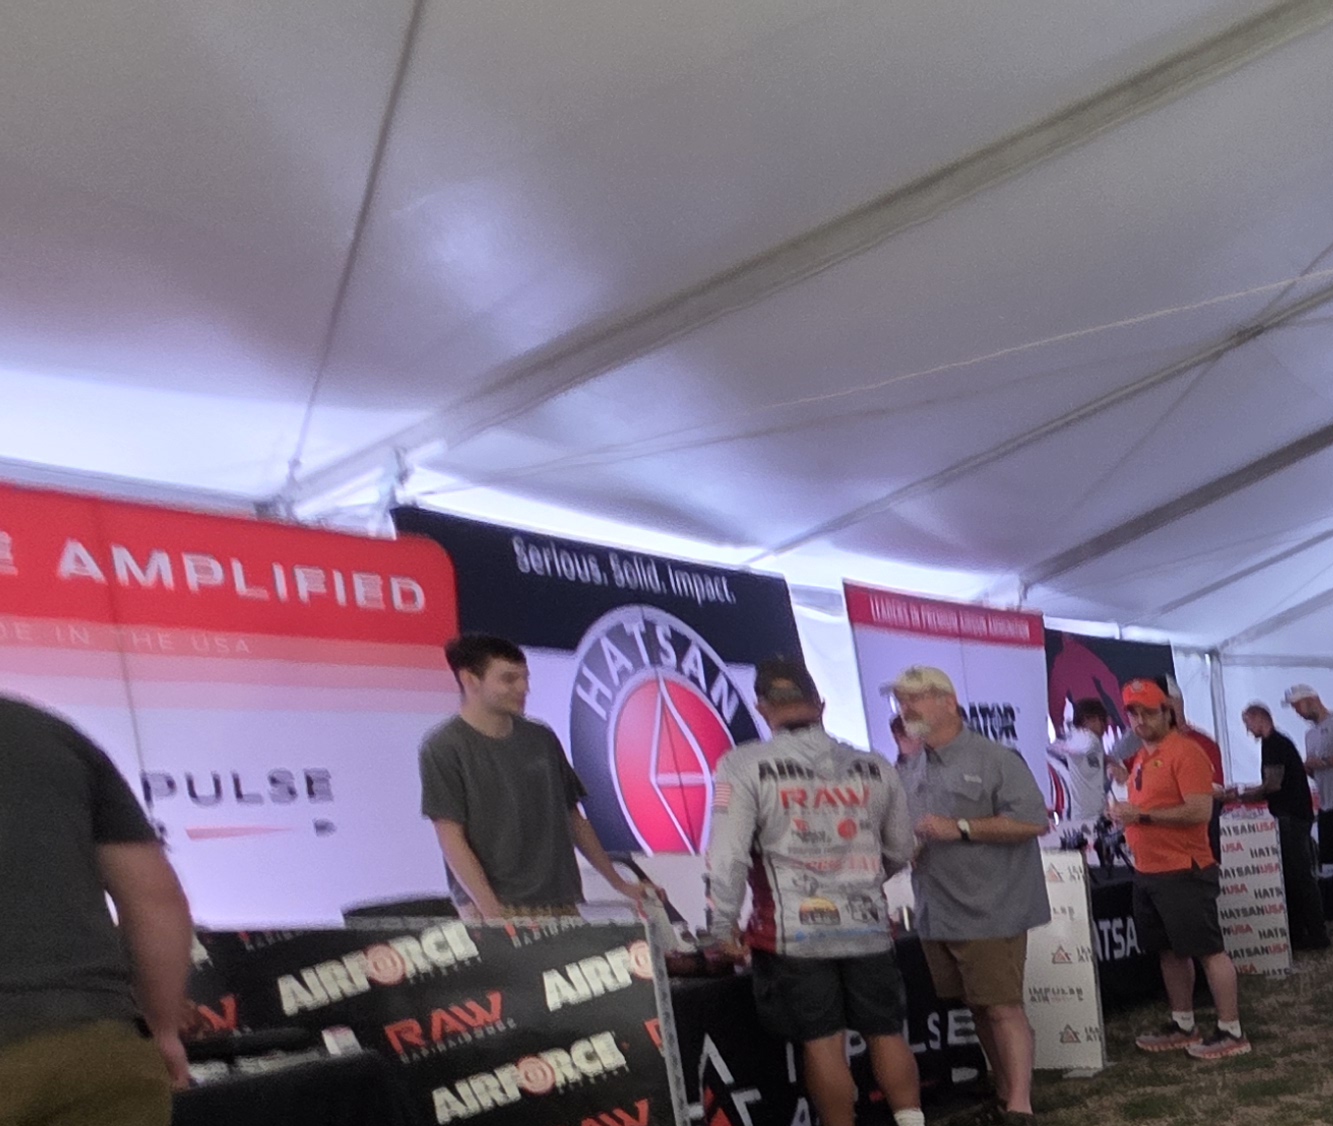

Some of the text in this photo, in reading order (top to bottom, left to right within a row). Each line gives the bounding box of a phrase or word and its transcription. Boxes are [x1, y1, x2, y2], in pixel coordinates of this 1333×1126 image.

[58, 538, 426, 613] AMPLIFIED
[512, 535, 608, 586] Serious.
[576, 617, 740, 724] HATSAN
[780, 785, 870, 810] RAW
[277, 921, 480, 1016] AIRFORCE
[384, 990, 503, 1056] RAW
[432, 1031, 627, 1126] AIRFORCE
